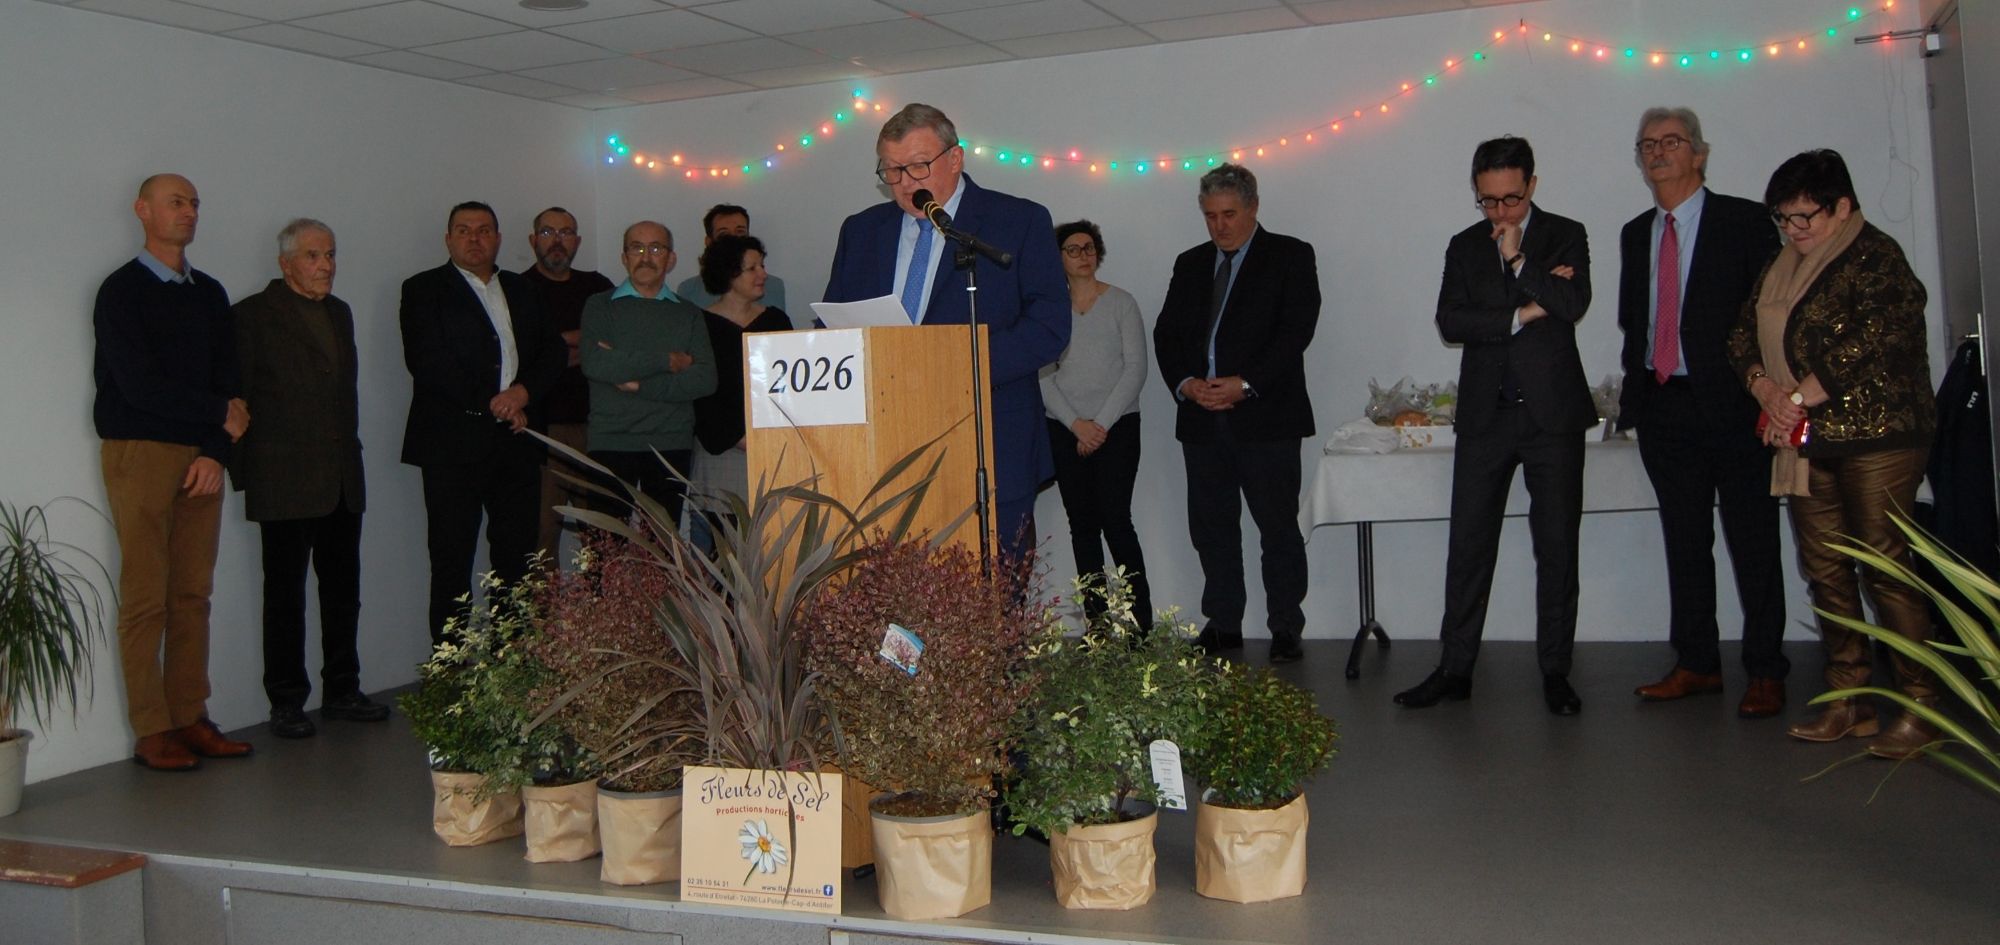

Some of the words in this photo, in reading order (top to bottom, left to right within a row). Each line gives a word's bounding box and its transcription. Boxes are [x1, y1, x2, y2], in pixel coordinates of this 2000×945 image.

[768, 354, 854, 394] 2026
[701, 773, 762, 805] Fleurs
[768, 779, 787, 799] de
[792, 781, 830, 812] Sel
[716, 805, 763, 816] Productions
[764, 806, 805, 822] hortices
[762, 885, 821, 895] www.flersdesel.fr
